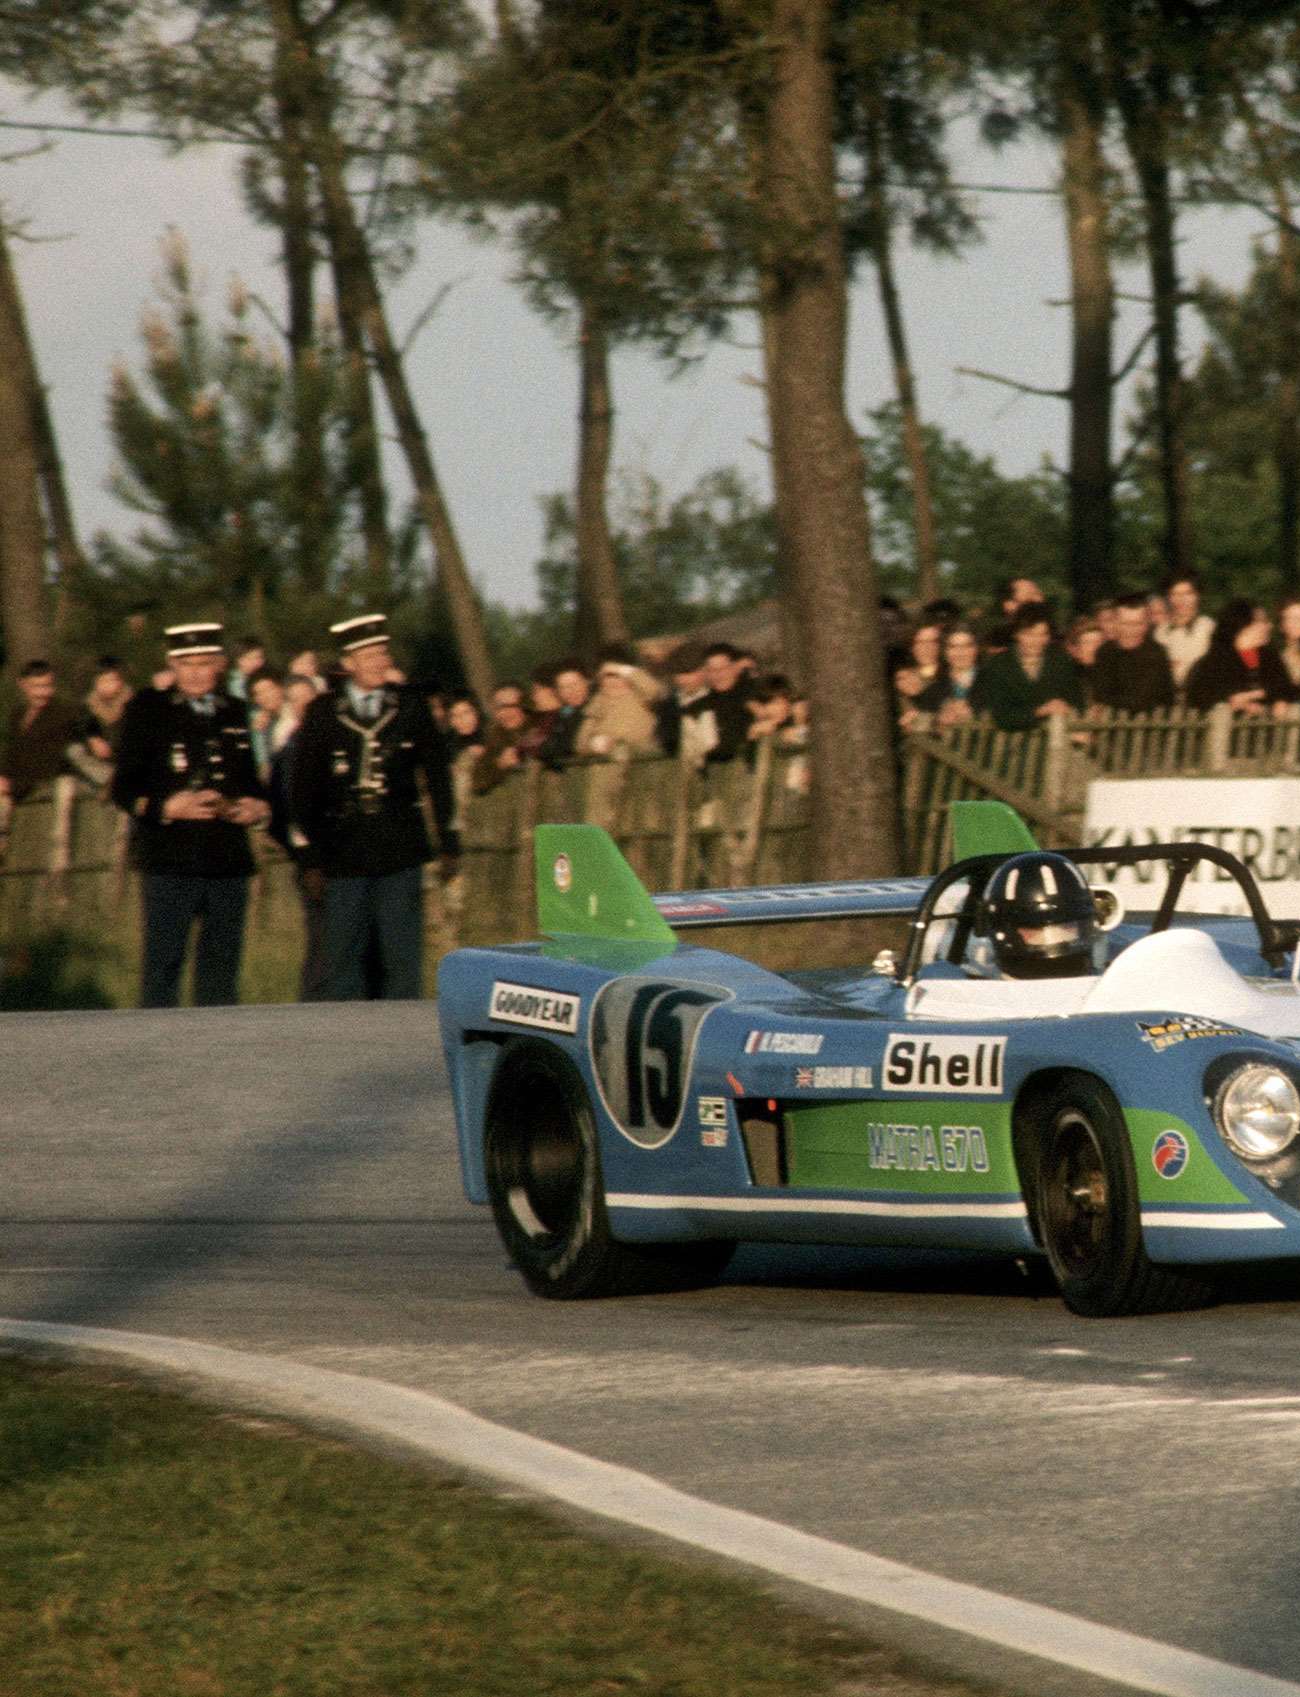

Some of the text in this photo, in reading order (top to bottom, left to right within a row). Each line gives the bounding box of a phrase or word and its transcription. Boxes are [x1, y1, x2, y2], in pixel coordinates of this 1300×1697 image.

[496, 989, 573, 1025] GOODYEAR
[887, 1041, 1001, 1087] Shell
[867, 1123, 990, 1172] MATRA 670
